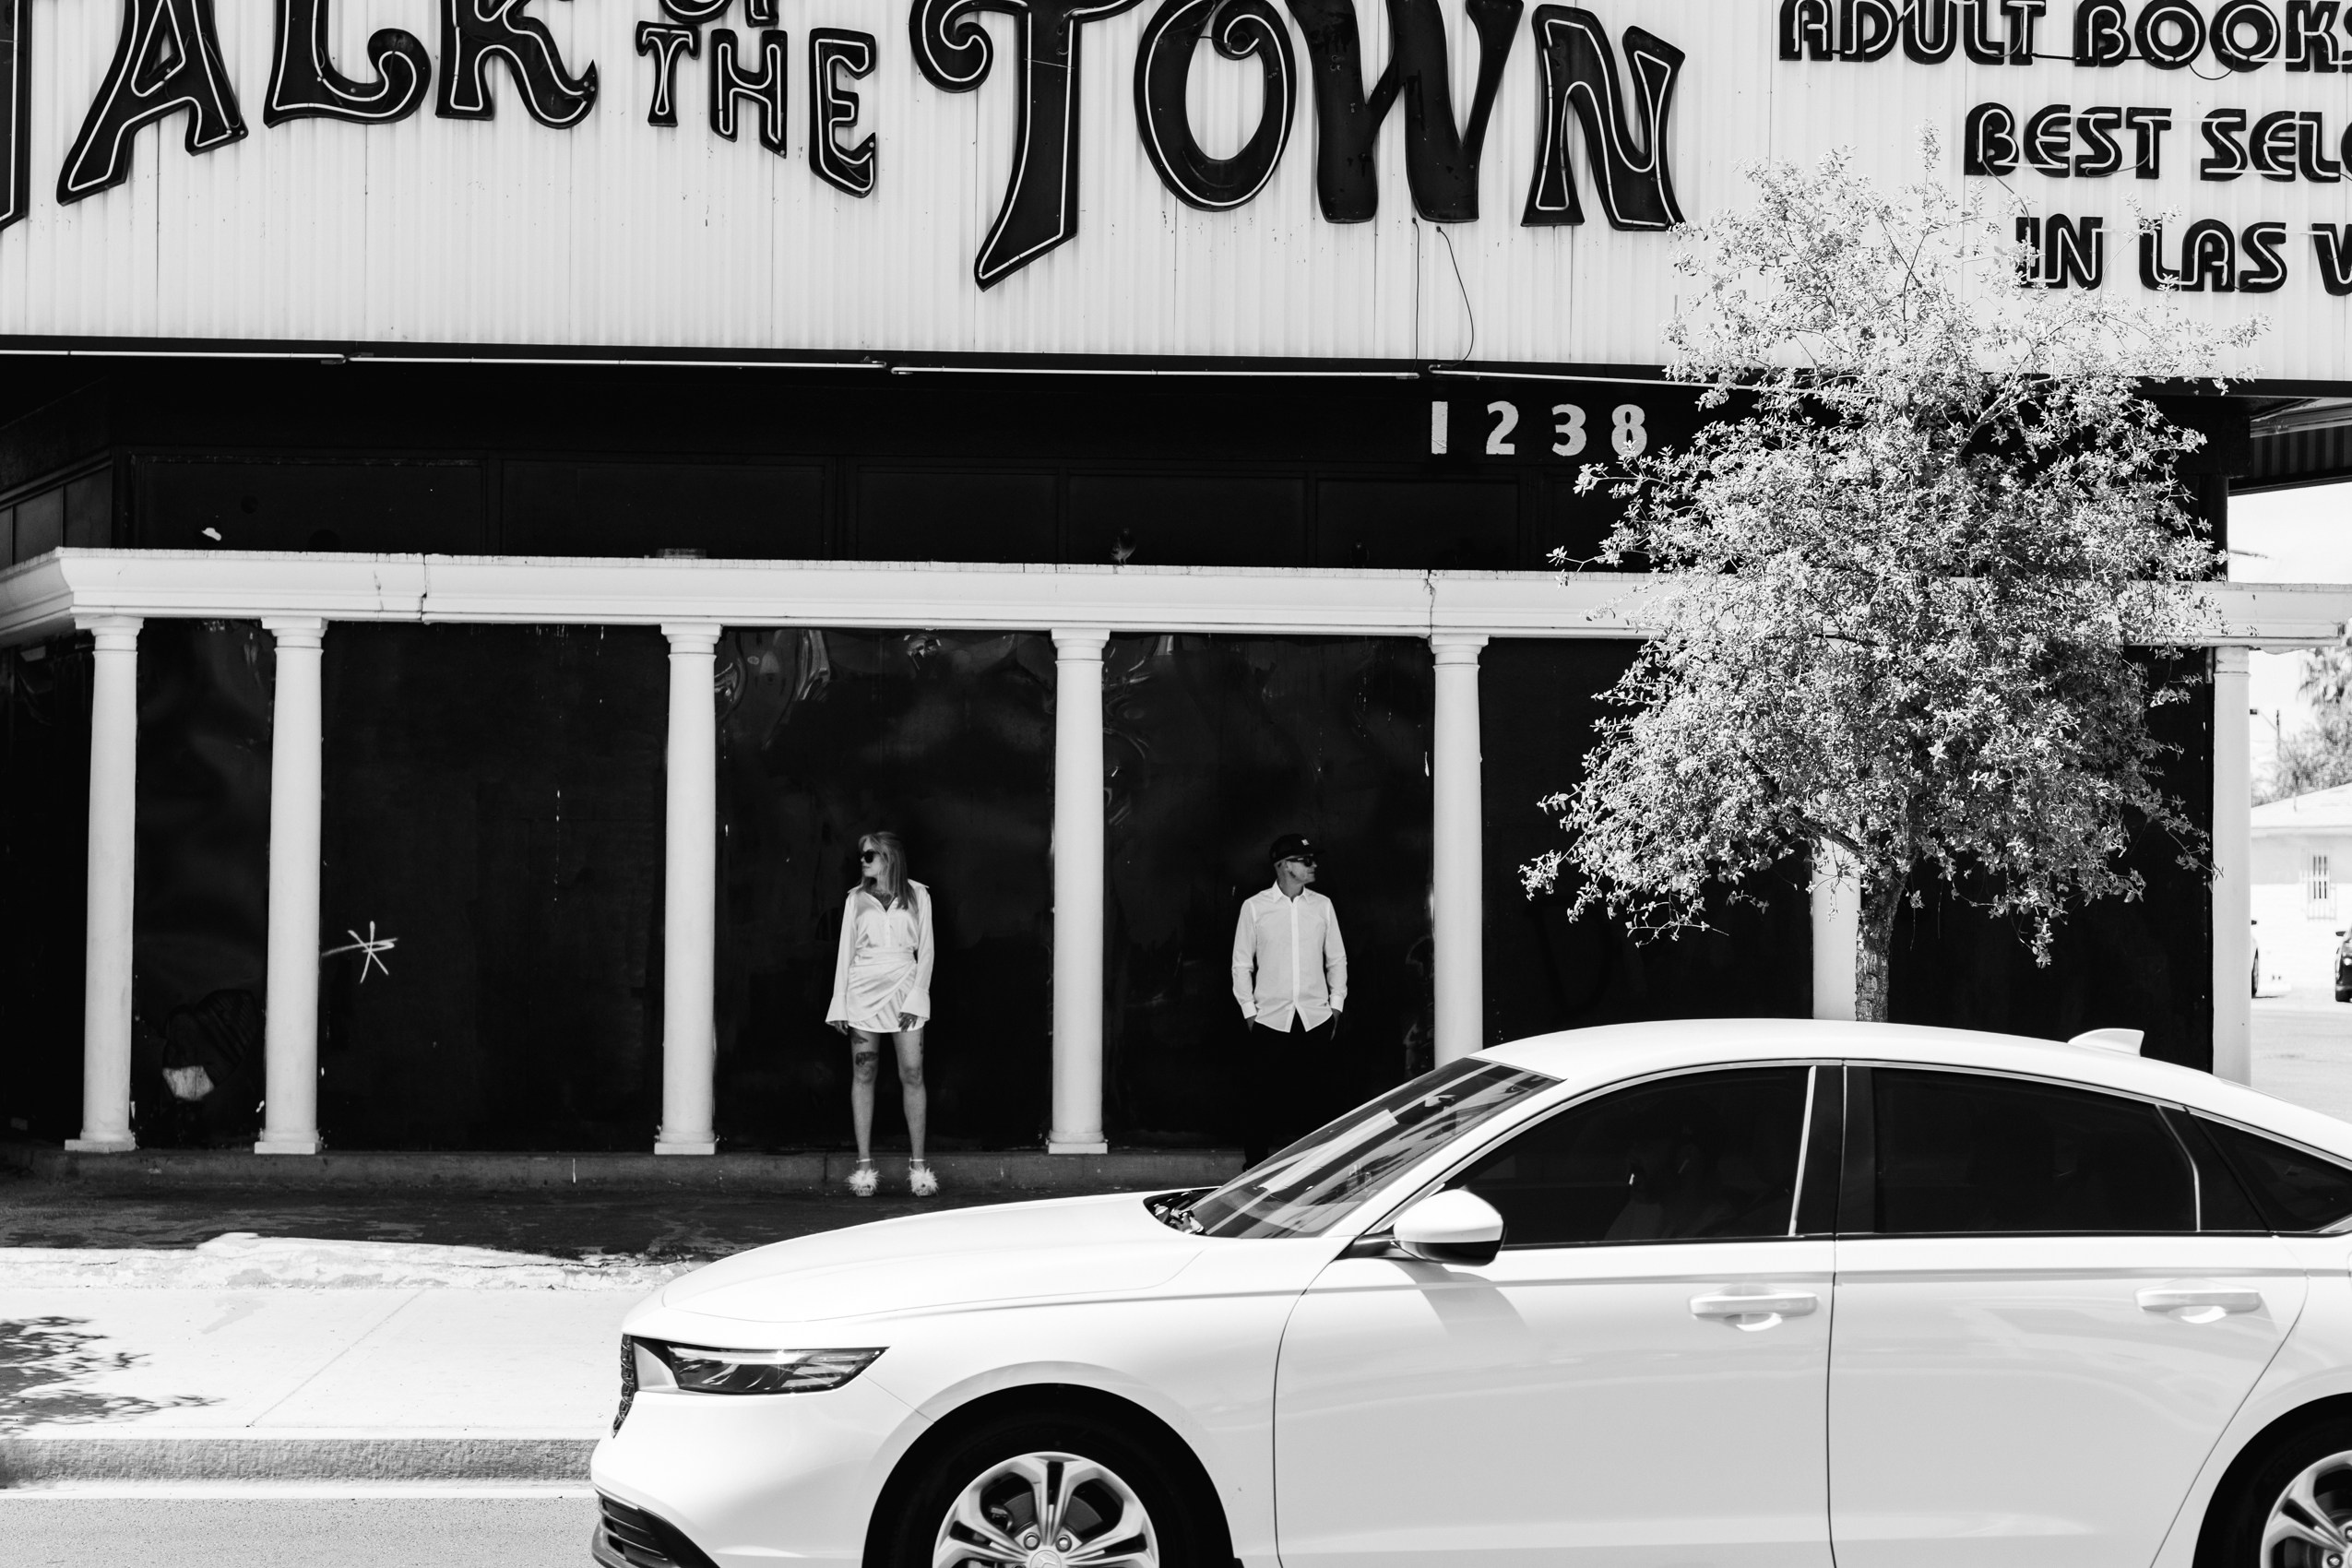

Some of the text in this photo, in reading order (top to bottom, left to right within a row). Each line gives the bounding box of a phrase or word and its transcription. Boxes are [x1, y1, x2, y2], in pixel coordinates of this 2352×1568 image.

[1779, 0, 2352, 73] ADULT BOOK
[0, 0, 599, 231] ALK
[636, 20, 877, 198] THE
[909, 0, 1686, 292] TOWN
[1964, 101, 2352, 183] BEST SEL
[2015, 215, 2104, 291] IN
[2138, 219, 2287, 294] LAS
[1431, 400, 1648, 459] 1238
